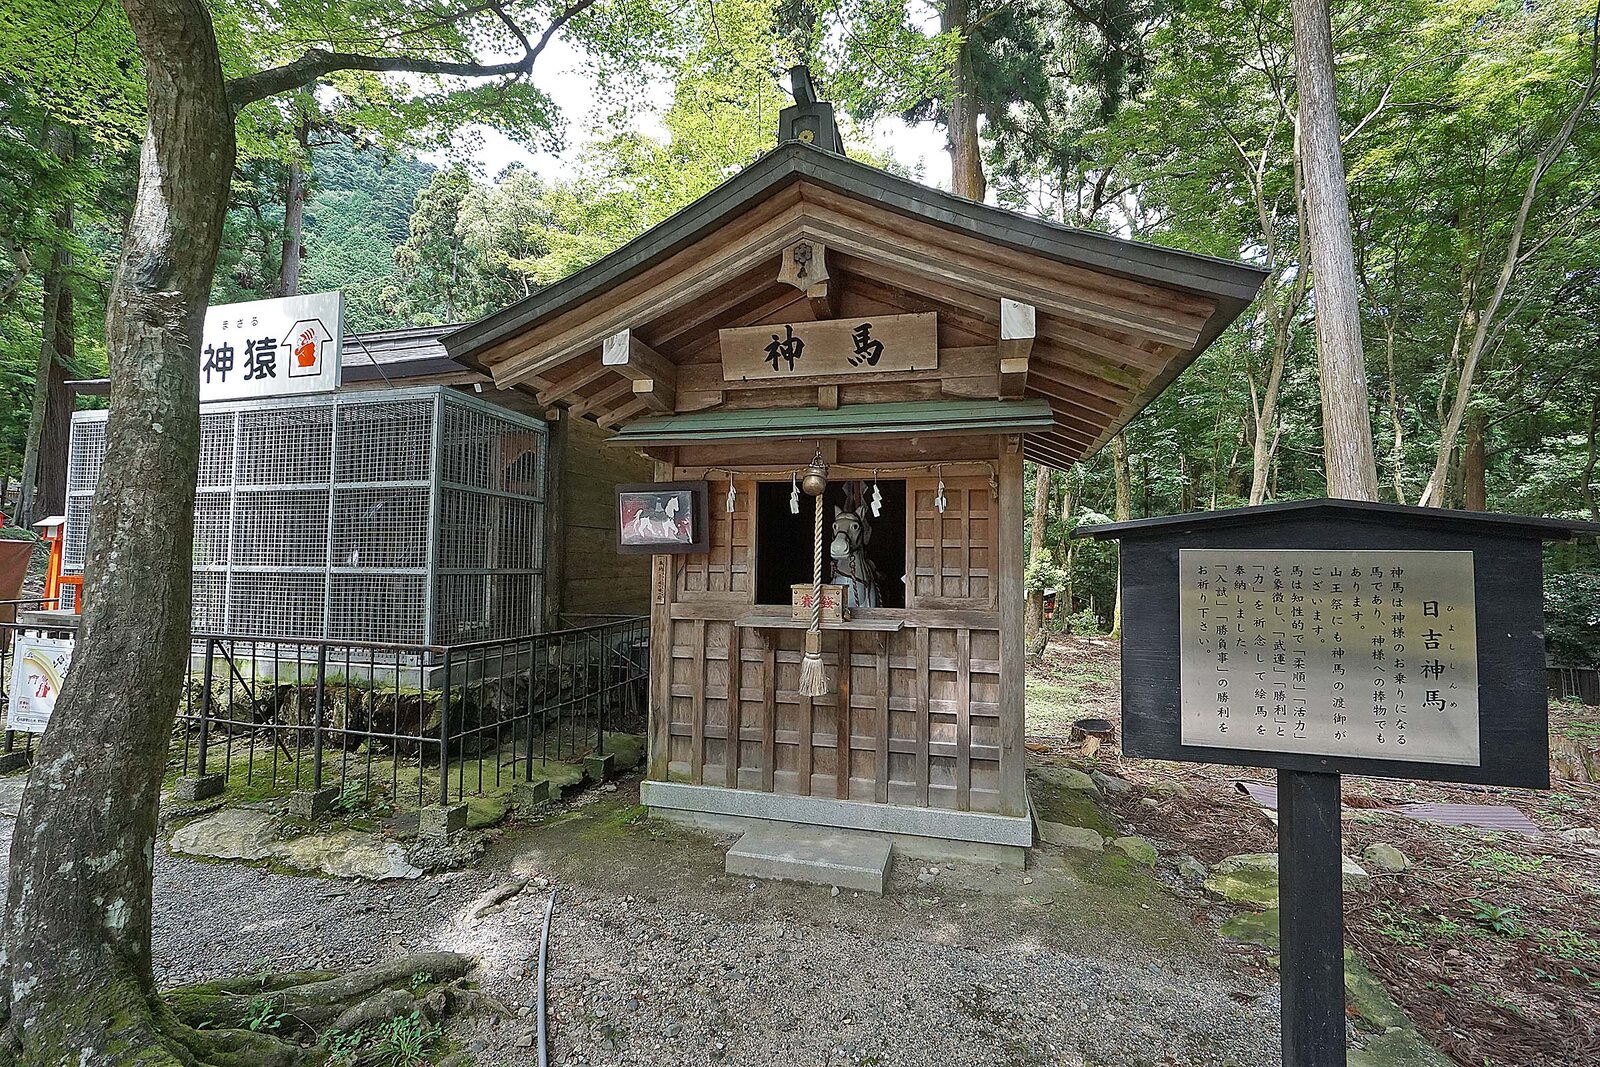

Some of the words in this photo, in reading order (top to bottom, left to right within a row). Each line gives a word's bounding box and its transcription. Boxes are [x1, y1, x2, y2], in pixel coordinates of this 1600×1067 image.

[203, 336, 278, 384] 神猿
[222, 316, 259, 330] まさる
[764, 323, 885, 372] 神馬
[1197, 565, 1212, 653] お祈り下さい。
[1233, 564, 1248, 655] 奉納しました。
[1311, 566, 1326, 643] ございます。
[1350, 566, 1366, 630] あります。
[1214, 564, 1229, 733] 「入試」「勝負事」の勝利を
[1252, 565, 1268, 735] 「力」を祈念して絵馬を
[1330, 566, 1347, 740] 山王祭にも神馬の渡御が
[1390, 566, 1408, 745] 神馬は神様のお乗りになる
[1420, 600, 1447, 712] 日吉神馬
[1446, 605, 1458, 708] ひよししんめ
